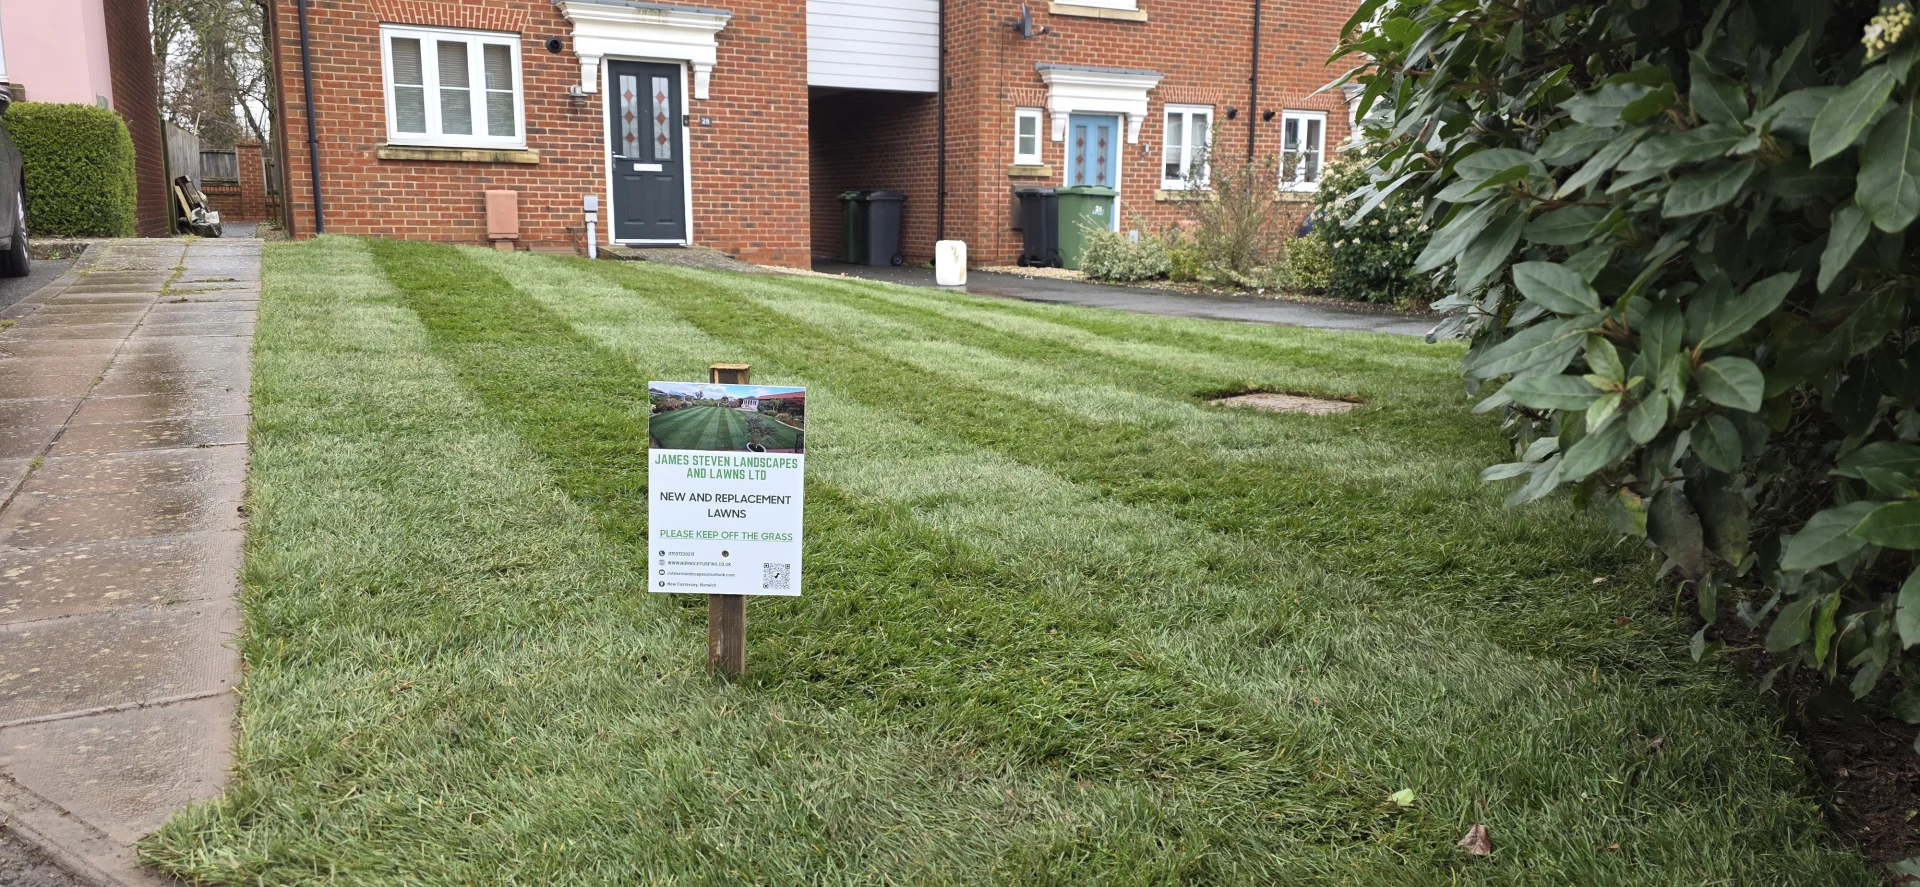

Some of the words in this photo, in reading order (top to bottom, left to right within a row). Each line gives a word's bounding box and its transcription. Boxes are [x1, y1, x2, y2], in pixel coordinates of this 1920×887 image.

[701, 117, 710, 125] 28
[655, 454, 689, 465] JAMES
[693, 456, 730, 466] STEVEN
[734, 457, 798, 468] LANDSCAPES
[687, 468, 706, 478] AND
[710, 469, 745, 479] LAWNS
[749, 470, 766, 480] LTD
[660, 492, 686, 501] NEW
[689, 493, 712, 502] AND
[715, 494, 791, 504] REPLACEMENT
[708, 509, 746, 518] LAWNS
[660, 530, 694, 538] PLEASE
[761, 533, 792, 541] GRASS
